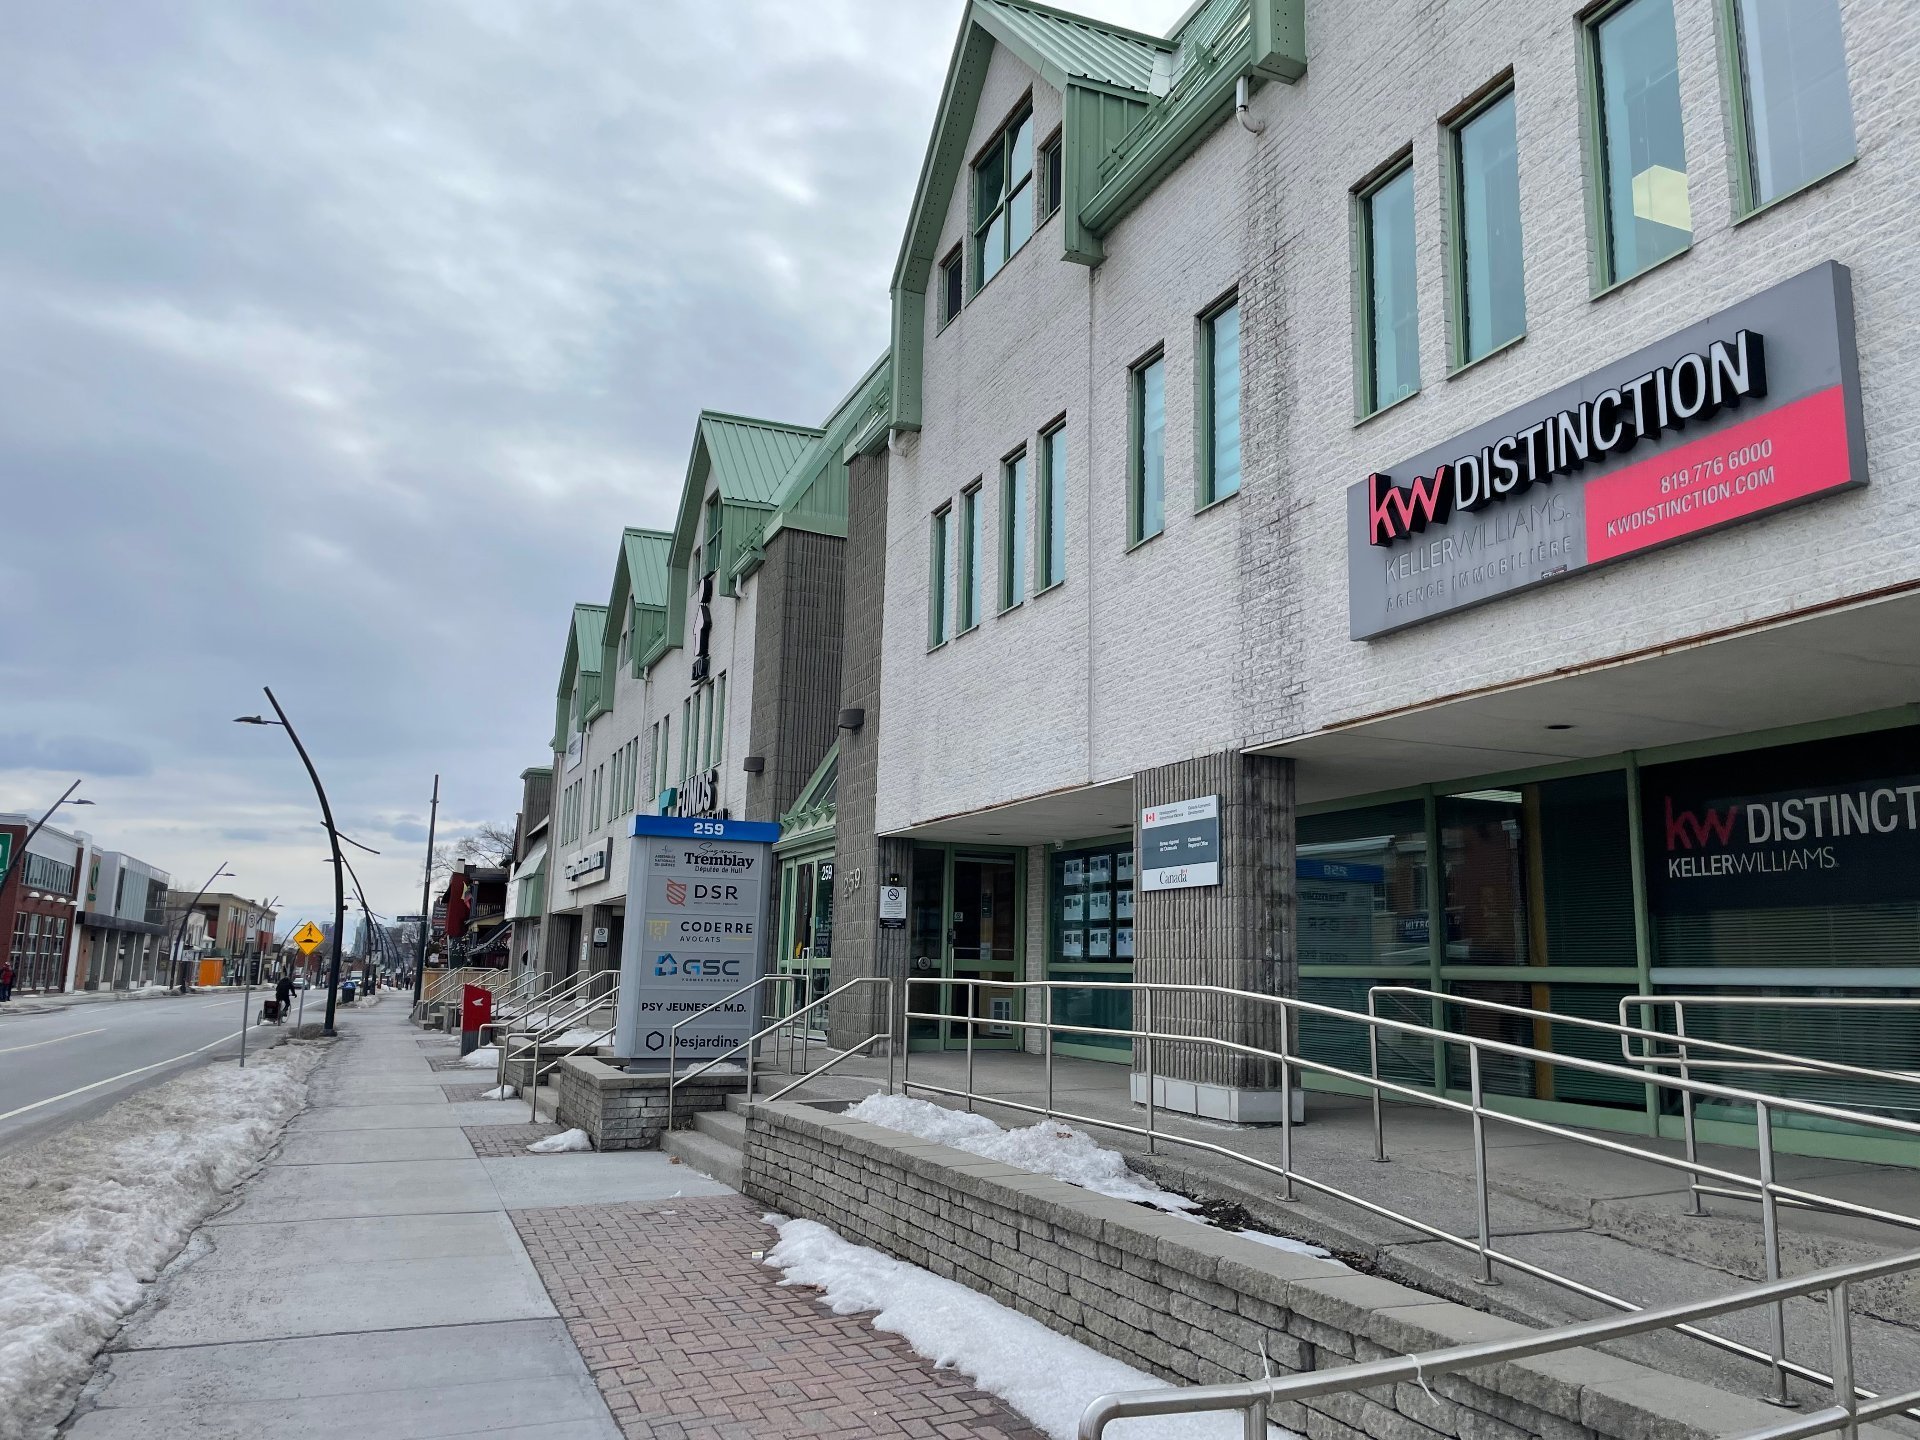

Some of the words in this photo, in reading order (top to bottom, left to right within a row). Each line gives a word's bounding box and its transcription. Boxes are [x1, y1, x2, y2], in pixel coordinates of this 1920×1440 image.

[1369, 465, 1450, 547] kw
[1454, 329, 1758, 511] DISTINCTION
[1661, 456, 1724, 493] 819.776
[1728, 439, 1773, 470] 6000
[1606, 466, 1775, 538] KWDISTINCTION.COM
[1386, 580, 1444, 612] AGENCE
[1452, 536, 1572, 591] IMMOBILIÈRE
[677, 769, 715, 818] FONDS
[693, 822, 724, 836] 259
[1665, 795, 1738, 850] kw
[684, 852, 754, 869] Tremblay
[821, 864, 833, 881] 259
[1159, 869, 1188, 885] Canada
[843, 867, 861, 898] 259
[694, 884, 738, 900] DSR
[680, 921, 753, 934] CODERRE
[679, 935, 721, 943] AVOCATS
[682, 959, 740, 976] GSC
[641, 1002, 664, 1012] PSY
[724, 1003, 747, 1013] M.D.
[669, 1035, 739, 1050] Desjardins
